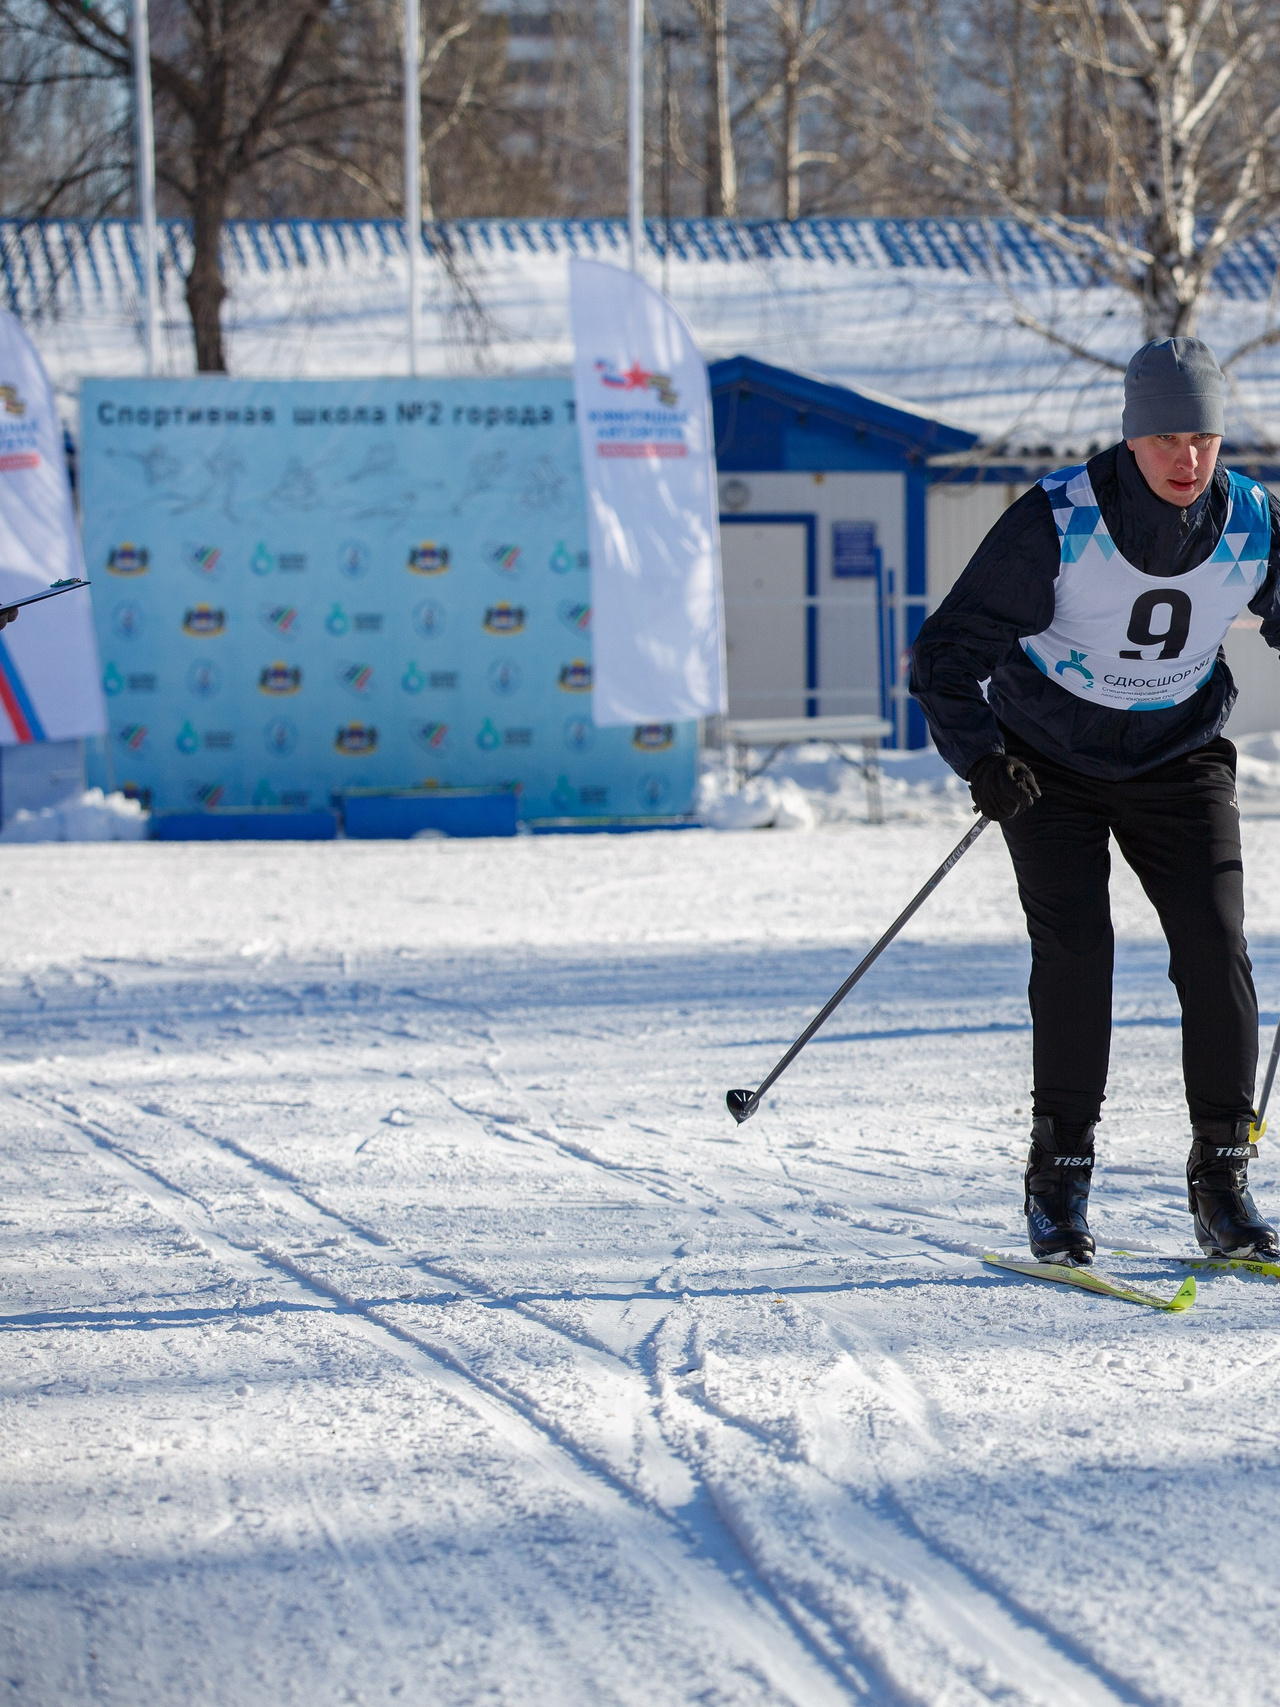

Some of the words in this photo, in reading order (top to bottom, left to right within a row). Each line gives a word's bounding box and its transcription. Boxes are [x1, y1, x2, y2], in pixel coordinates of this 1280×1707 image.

[97, 401, 276, 431] Спортивная
[292, 405, 386, 426] школа
[453, 405, 555, 430] города
[1119, 588, 1192, 660] 9
[1103, 670, 1192, 688] СДЮСШОР
[1216, 1146, 1251, 1157] TISA
[1053, 1156, 1092, 1167] TISA
